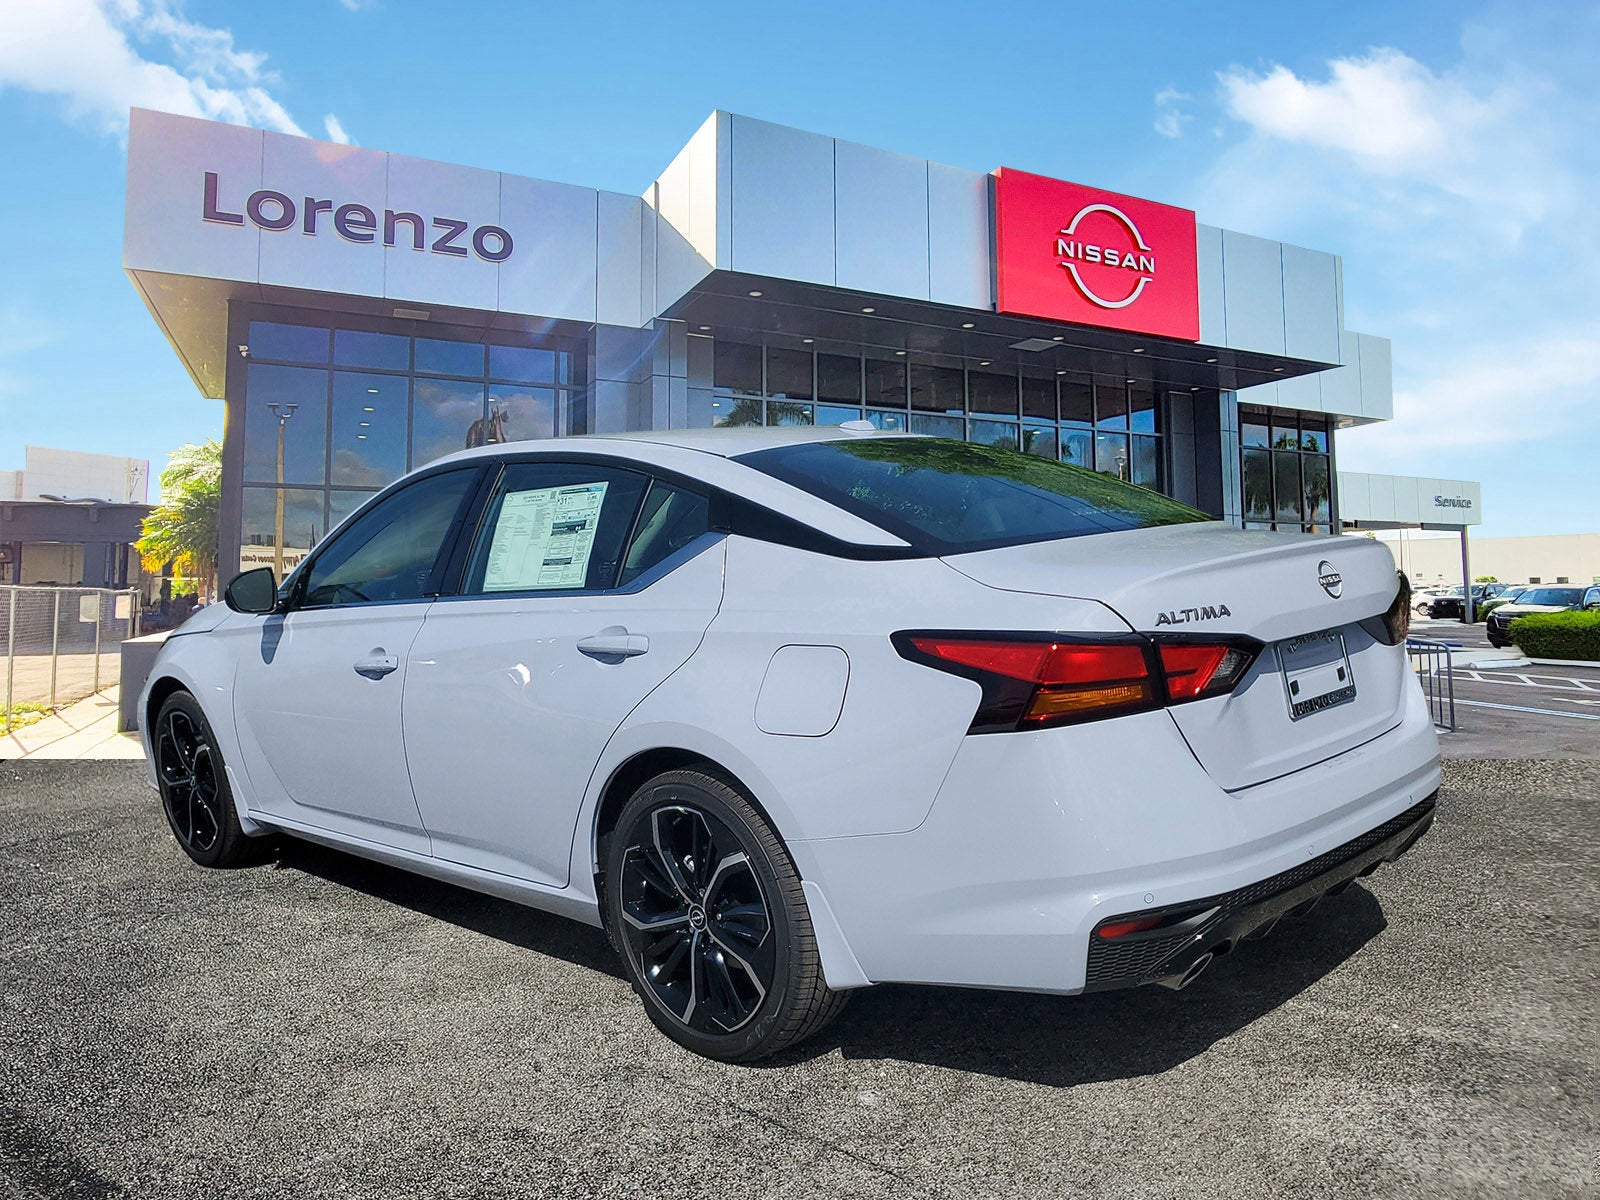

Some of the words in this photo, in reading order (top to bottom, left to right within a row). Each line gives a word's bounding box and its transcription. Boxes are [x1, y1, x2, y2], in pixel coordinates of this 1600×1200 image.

[202, 171, 514, 262] Lorenzo
[1057, 238, 1155, 274] NISSAN
[1434, 495, 1472, 508] Service
[1155, 604, 1231, 626] ALTIMA
